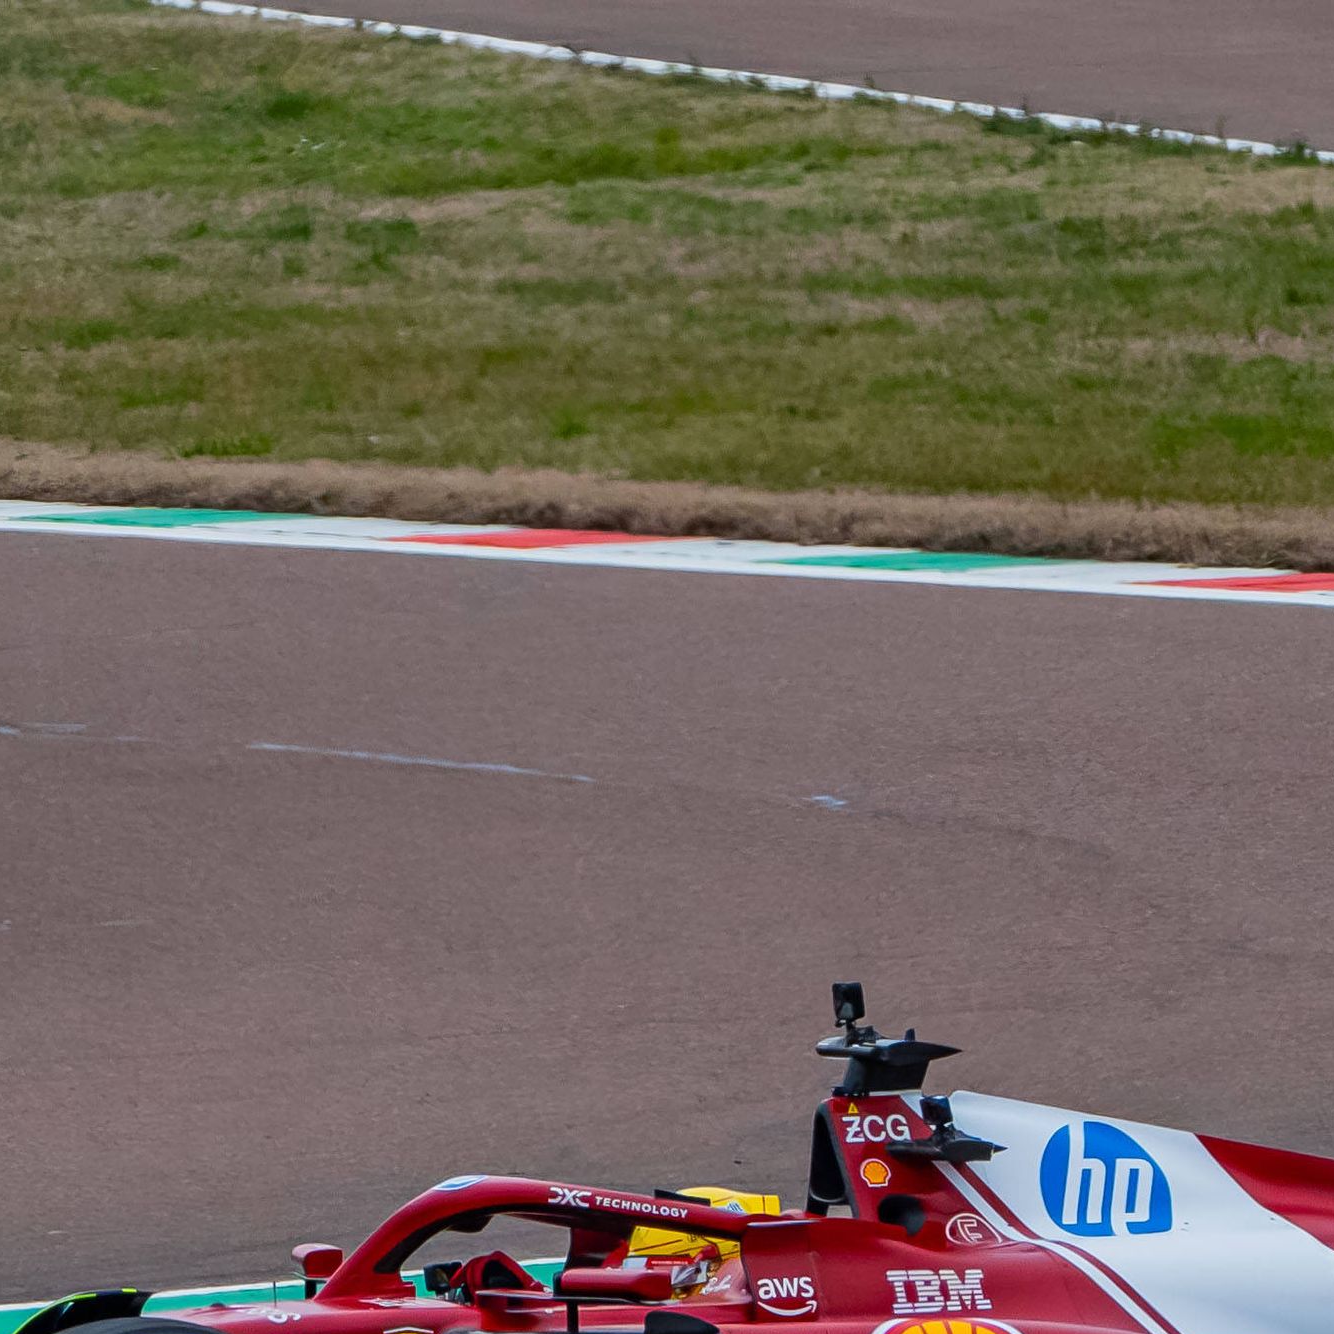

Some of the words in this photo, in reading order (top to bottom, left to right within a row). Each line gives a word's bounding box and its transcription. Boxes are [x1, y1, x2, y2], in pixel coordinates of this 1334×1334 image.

[842, 1114, 913, 1143] ZCG
[1061, 1121, 1154, 1237] hp
[548, 1186, 592, 1208] DXC
[595, 1196, 689, 1218] TECHNOLOGY
[757, 1276, 815, 1300] aws
[885, 1269, 993, 1314] IBM
